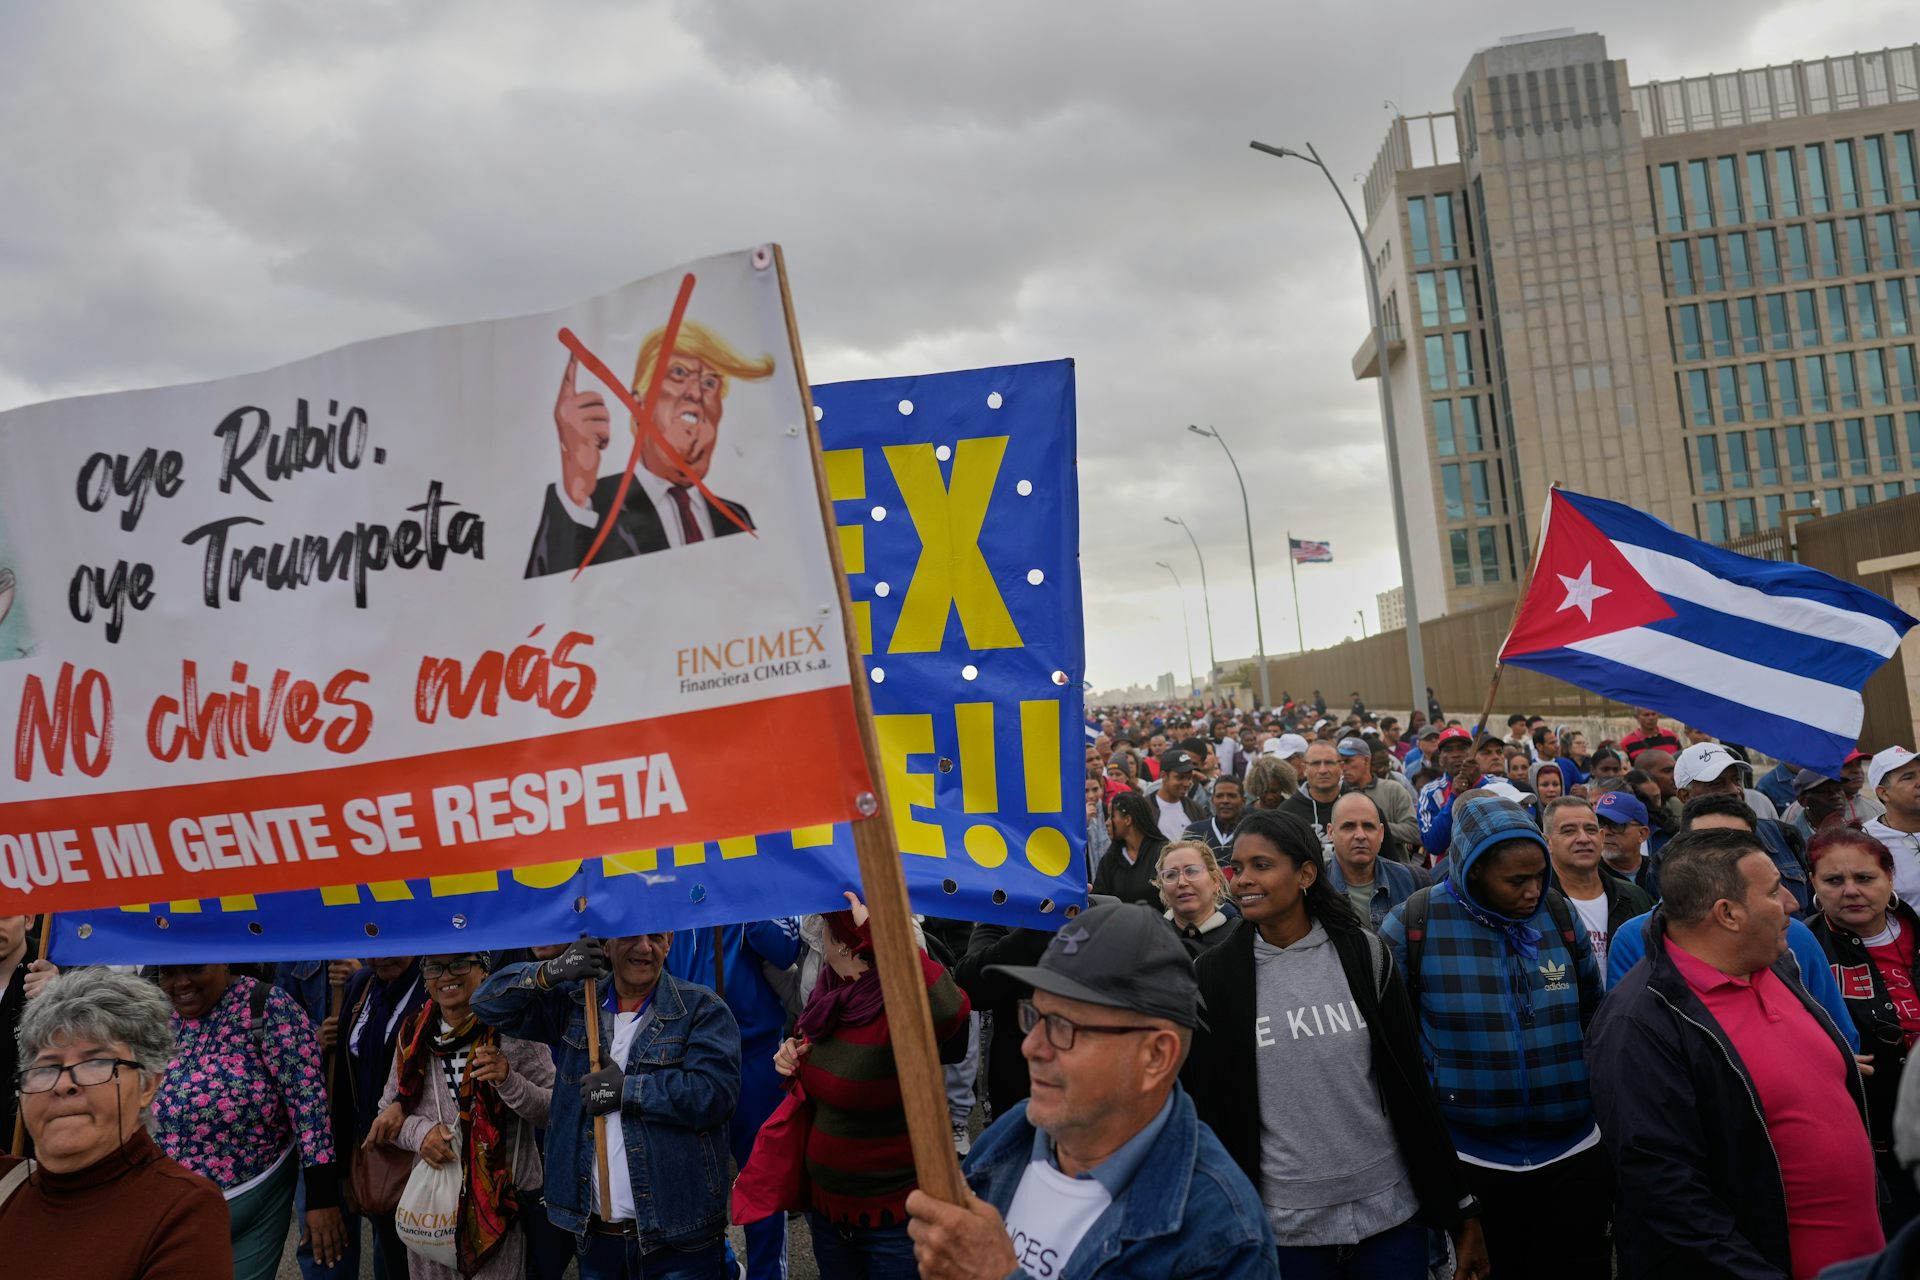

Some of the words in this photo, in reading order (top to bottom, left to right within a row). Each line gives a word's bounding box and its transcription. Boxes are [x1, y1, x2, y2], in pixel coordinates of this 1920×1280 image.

[76, 446, 184, 531] oye
[214, 398, 386, 502] Rubio.
[69, 560, 155, 643] oye
[182, 480, 484, 609] Trumpeta
[677, 624, 824, 676] FINCIMEX
[680, 672, 749, 693] Financiera
[754, 660, 801, 681] CIMEX
[806, 658, 831, 672] s.a.
[15, 661, 113, 782] NO
[147, 659, 373, 754] chives
[415, 624, 597, 724] más
[0, 829, 90, 894] QUE
[91, 822, 164, 879] MI
[169, 803, 339, 872] GENTE
[342, 792, 422, 856] SE
[432, 752, 689, 846] RESPETA
[1544, 982, 1570, 991] adidas
[1829, 963, 1874, 999] E
[591, 1089, 614, 1102] HyFlex
[398, 1222, 431, 1237] Financiera
